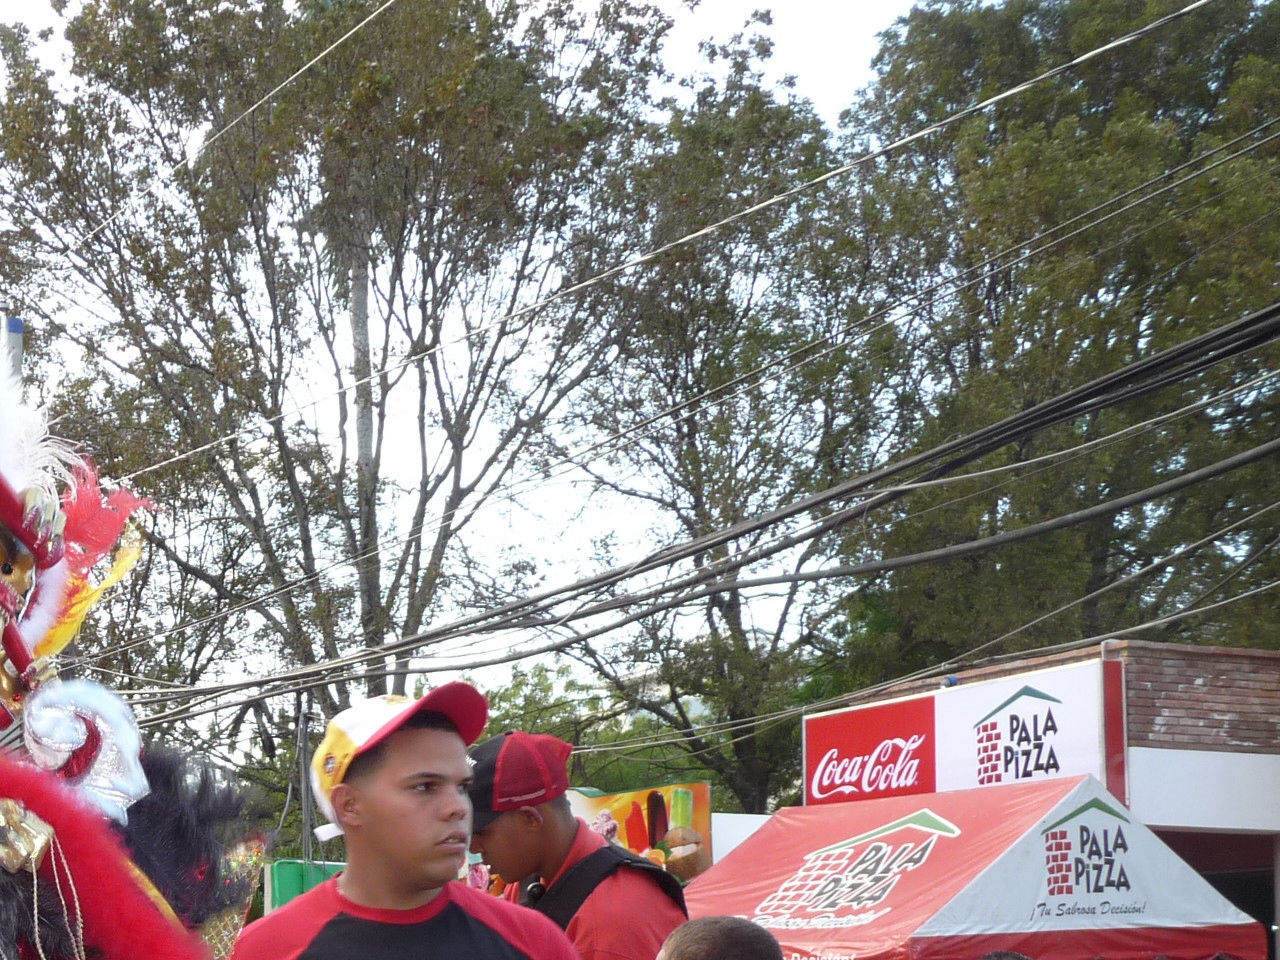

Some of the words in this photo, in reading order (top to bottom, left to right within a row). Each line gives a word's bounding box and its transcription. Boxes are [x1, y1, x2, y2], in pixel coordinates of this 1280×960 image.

[1009, 706, 1058, 746] PALA
[811, 734, 925, 798] Coca-Cola
[847, 835, 937, 880] PALA
[1079, 824, 1128, 861] PALA
[1055, 901, 1096, 917] Sabrosa
